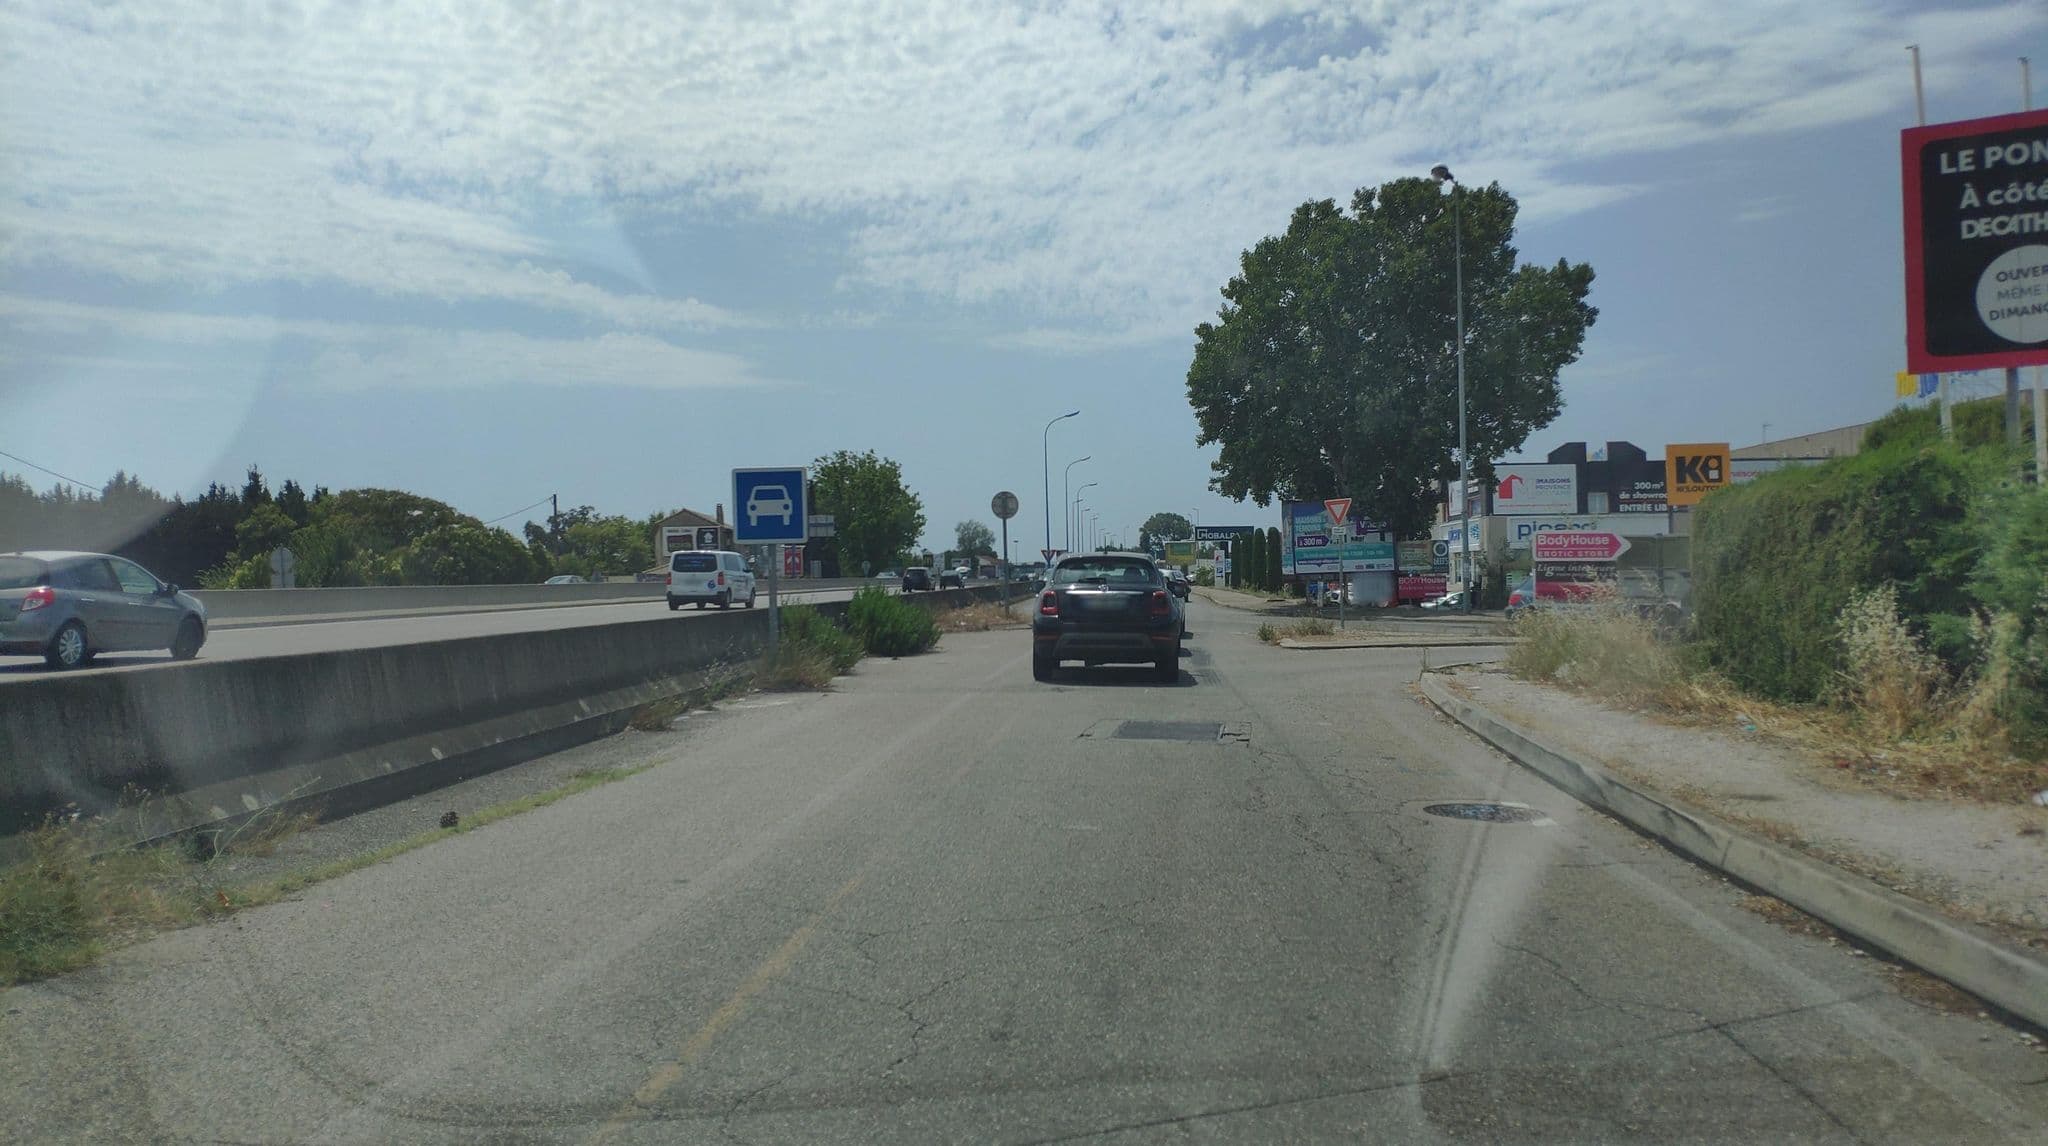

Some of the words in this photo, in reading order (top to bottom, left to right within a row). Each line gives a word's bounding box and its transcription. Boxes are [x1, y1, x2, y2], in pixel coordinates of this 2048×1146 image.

[1940, 150, 1975, 174] LE
[1960, 182, 1980, 209] À
[1987, 180, 2048, 206] côté
[1634, 482, 1652, 490] 300
[1677, 485, 1718, 494] KILOUT
[1619, 491, 1631, 499] de
[1619, 501, 1654, 512] ENTRÉE
[1303, 538, 1316, 546] 300
[1537, 550, 1574, 558] EROTIC
[1577, 550, 1609, 558] STORE
[1567, 563, 1616, 573] intieure
